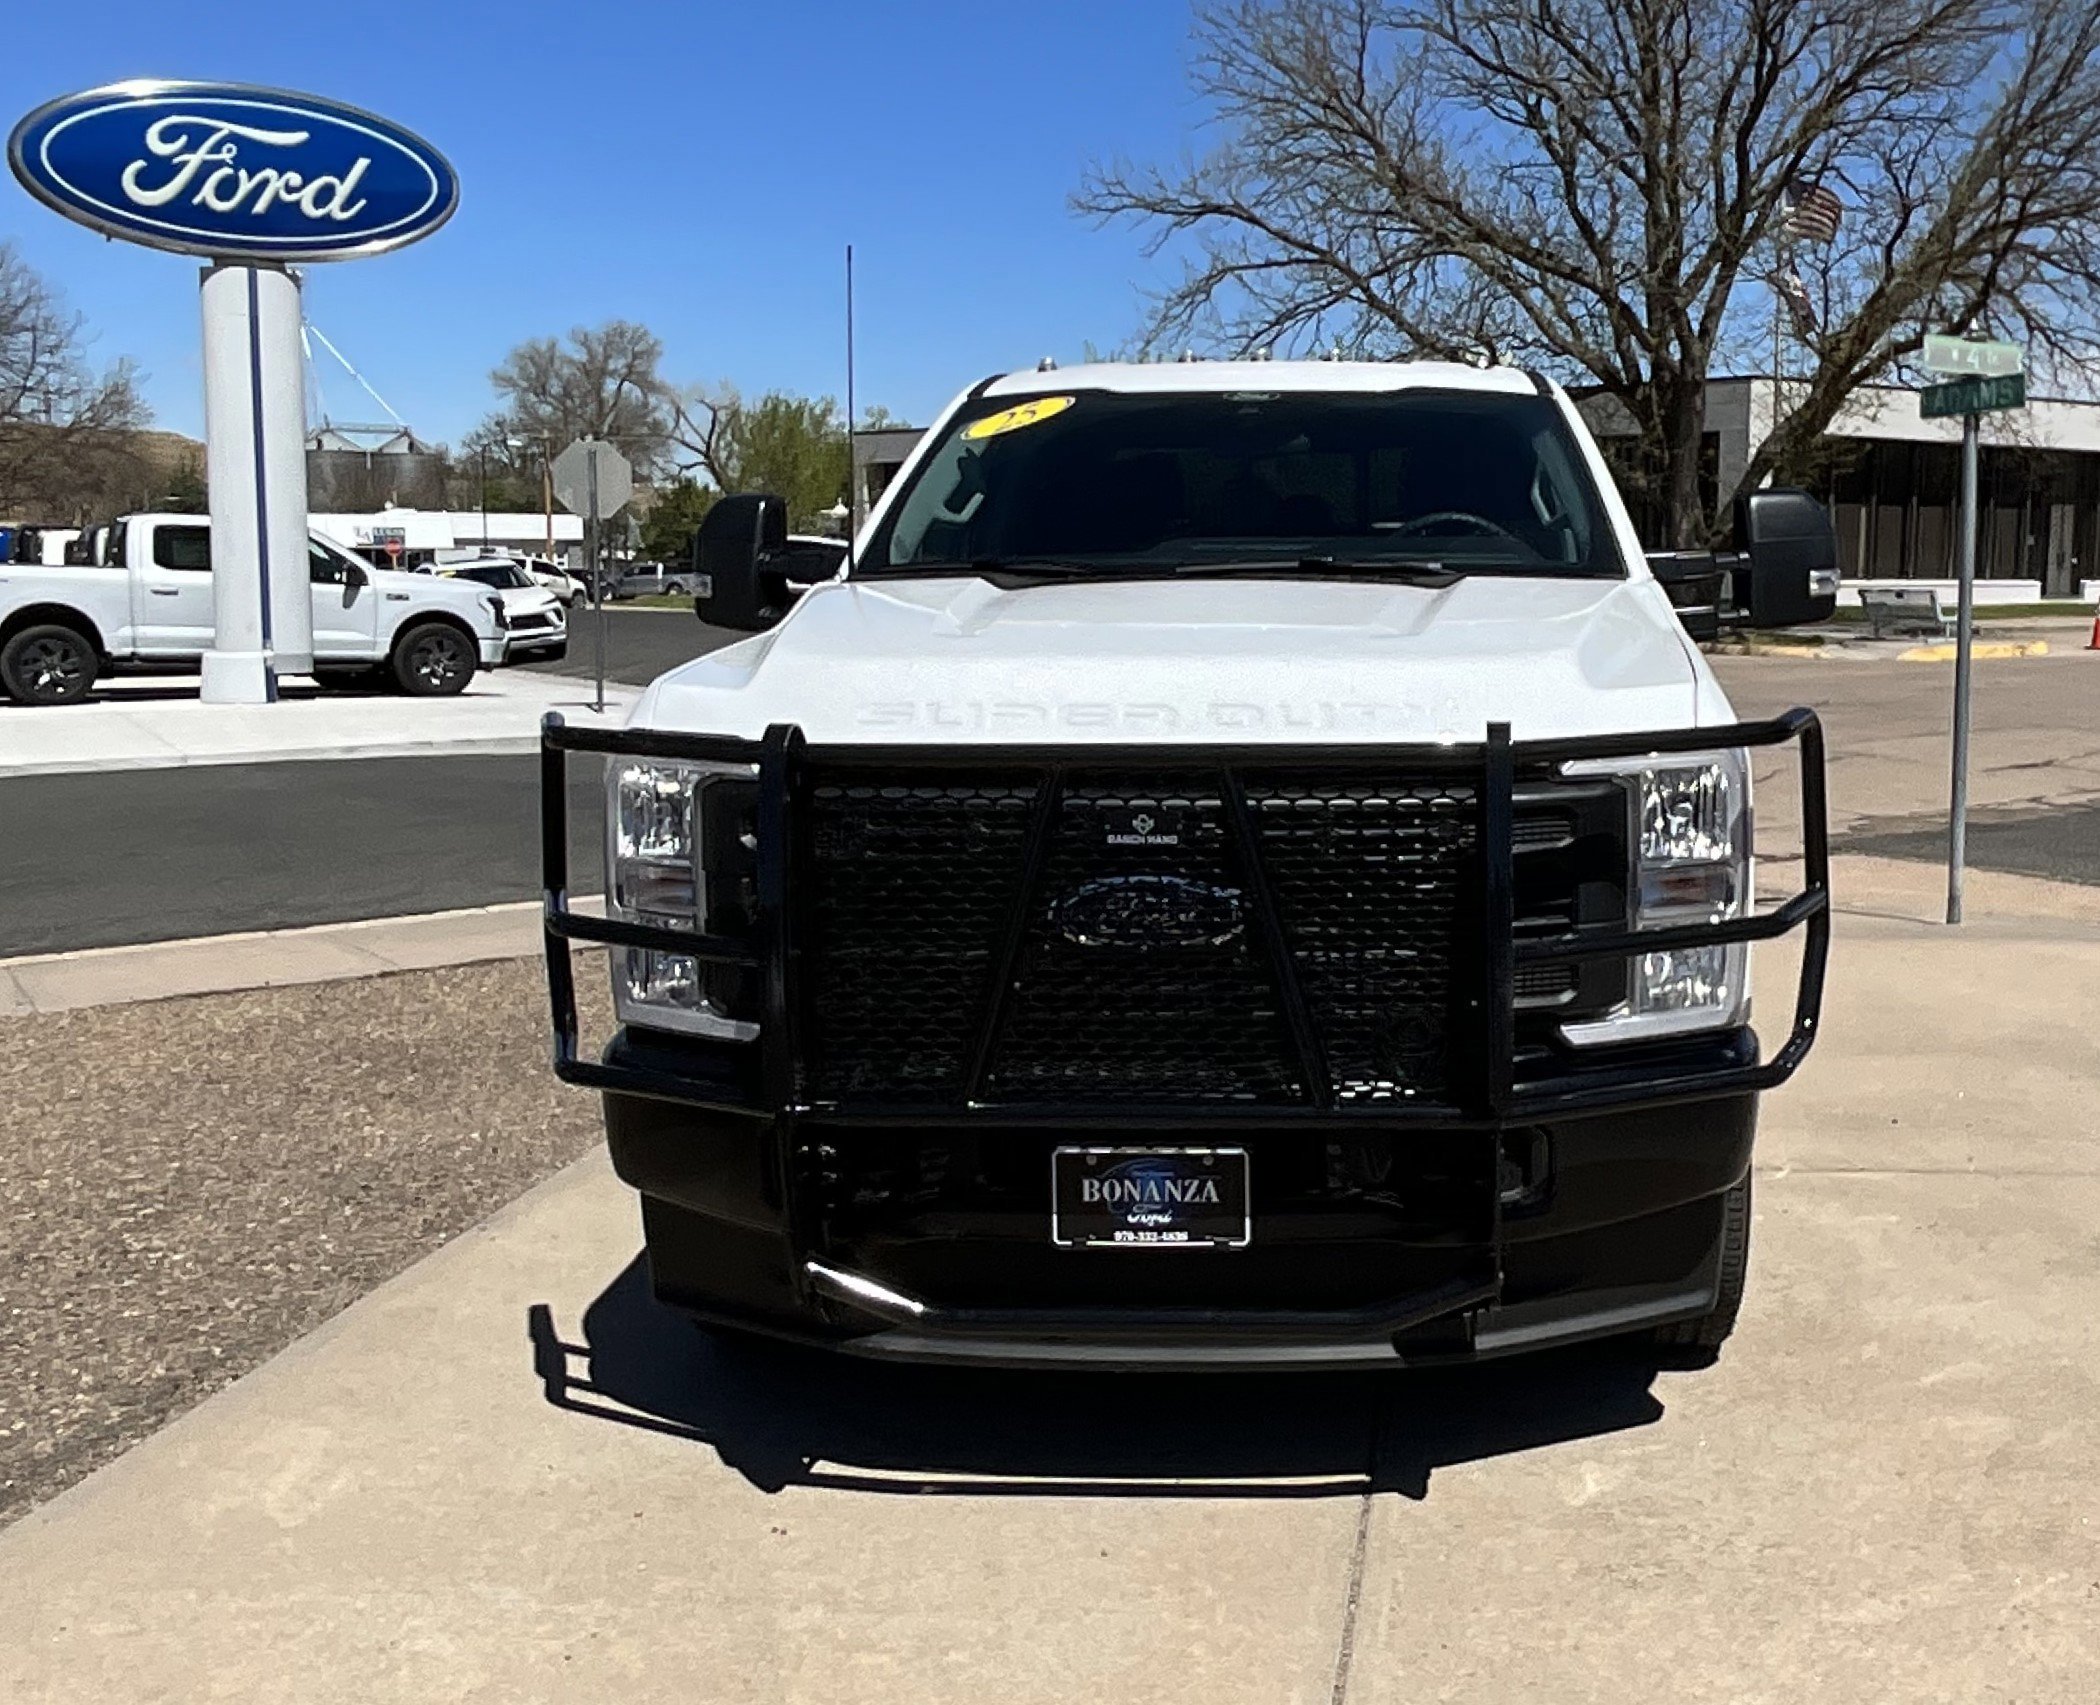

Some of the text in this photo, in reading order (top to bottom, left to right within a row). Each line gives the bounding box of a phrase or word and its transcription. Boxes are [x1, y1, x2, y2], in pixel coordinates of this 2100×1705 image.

[121, 115, 371, 221] Ford
[995, 403, 1038, 431] 25
[856, 702, 1438, 727] SUPER DUTY
[1082, 1178, 1219, 1202] BONANZA
